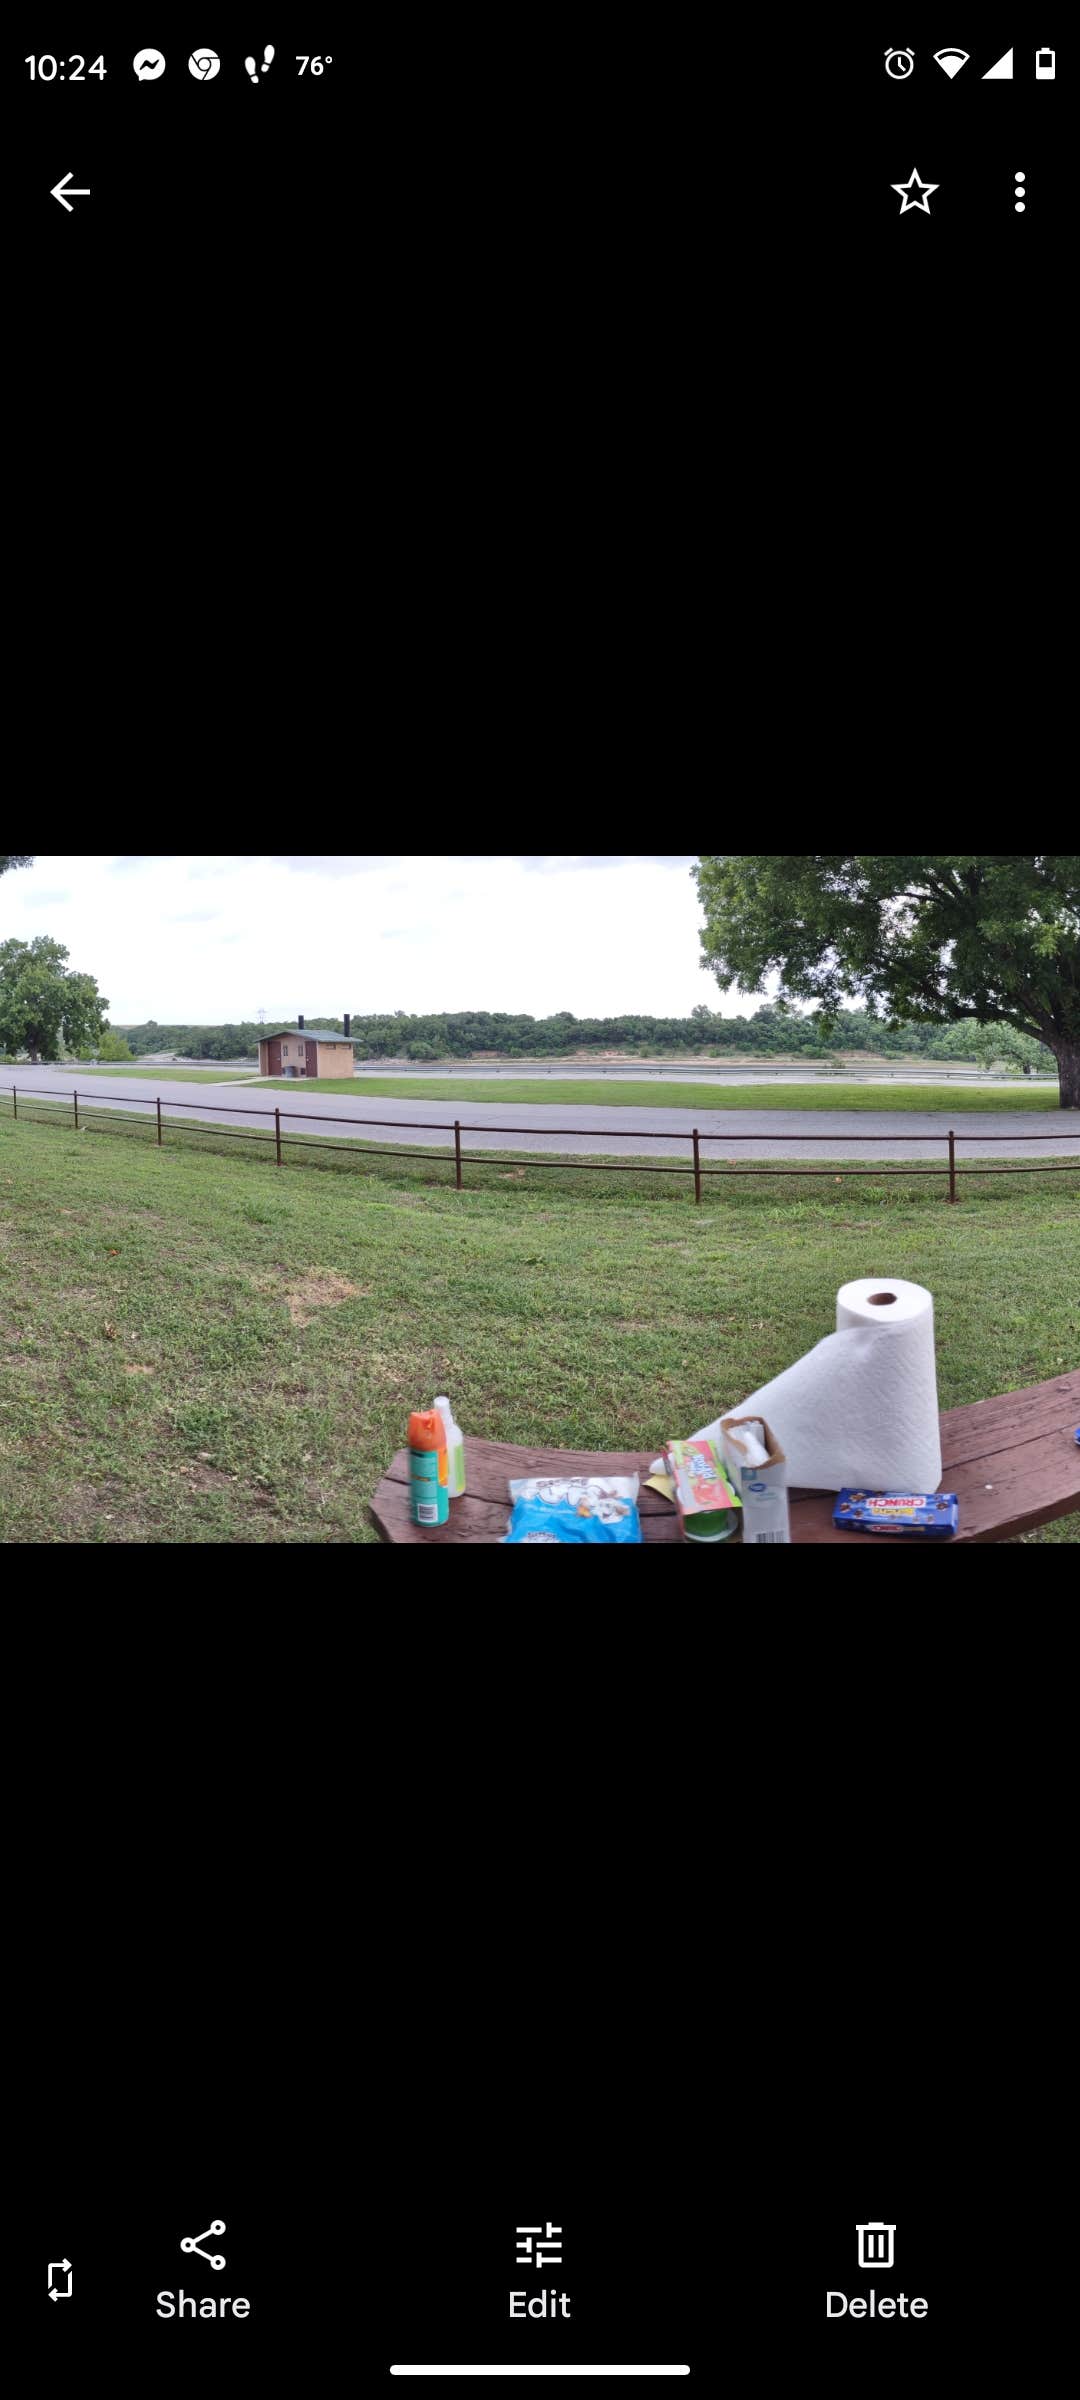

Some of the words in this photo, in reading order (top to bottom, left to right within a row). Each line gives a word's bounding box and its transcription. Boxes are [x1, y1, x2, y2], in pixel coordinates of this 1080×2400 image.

[24, 54, 108, 82] 10:24
[868, 1498, 925, 1507] CRUNCH
[155, 2289, 251, 2319] Share
[509, 2289, 571, 2319] Edit
[826, 2289, 929, 2319] Delete
